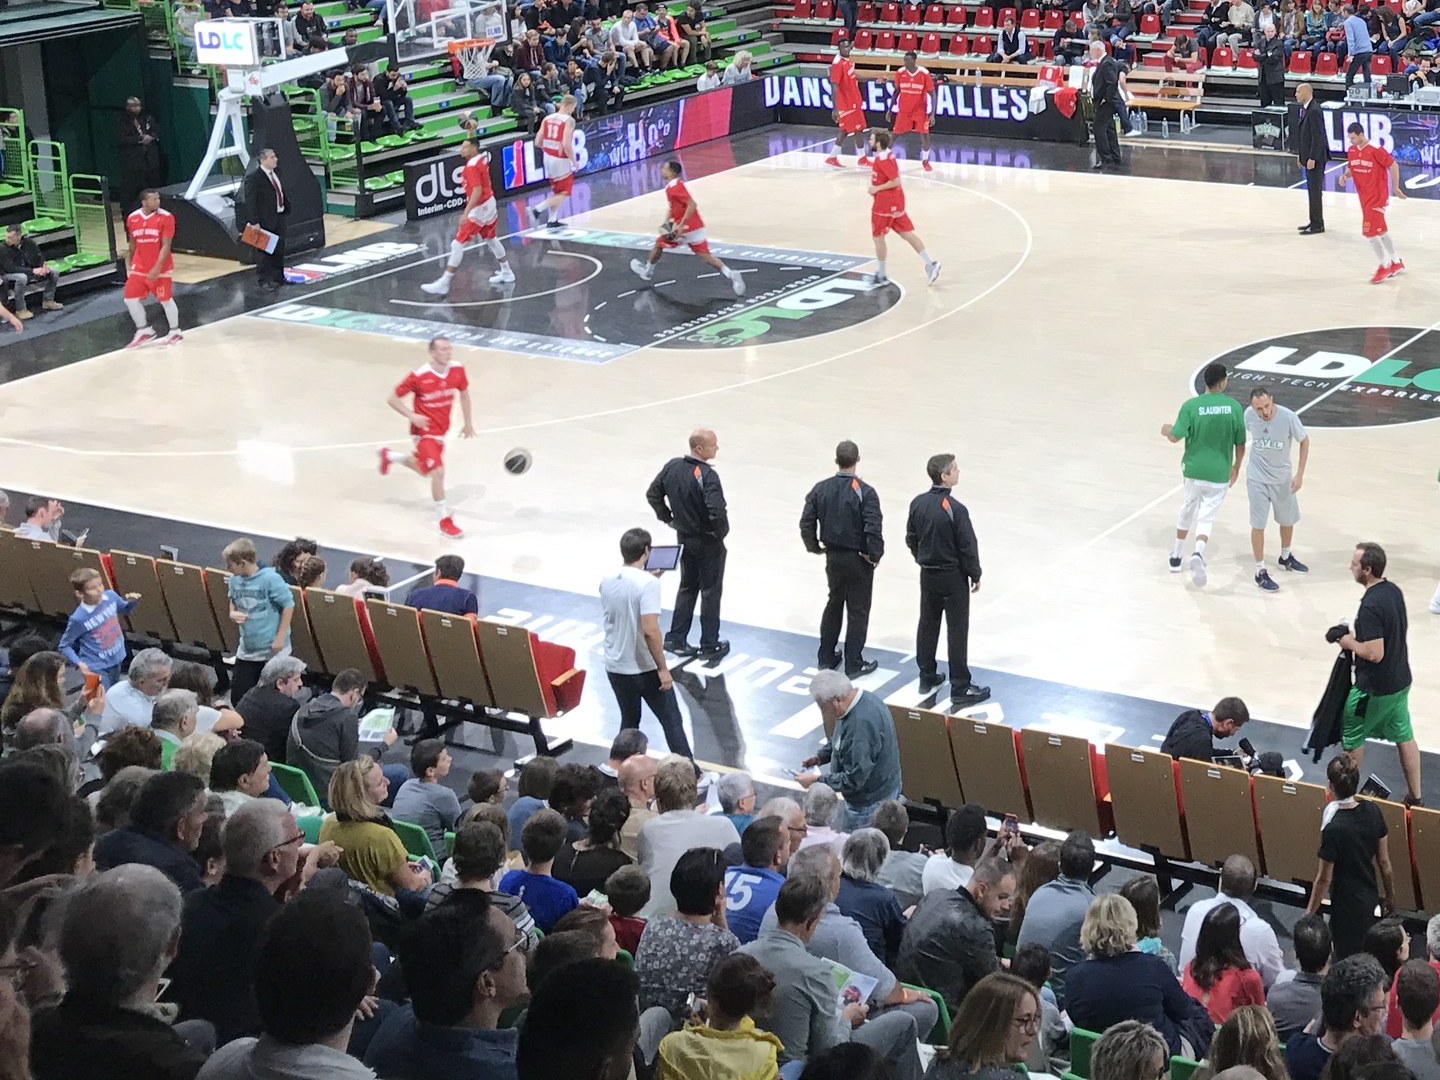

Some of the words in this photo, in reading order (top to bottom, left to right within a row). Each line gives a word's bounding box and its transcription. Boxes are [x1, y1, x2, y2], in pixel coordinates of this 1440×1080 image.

[198, 30, 243, 50] LDLC
[926, 83, 1030, 122] ALLES
[523, 128, 588, 185] LB
[1198, 405, 1232, 416] SLAUGHTER
[84, 614, 101, 631] NEW
